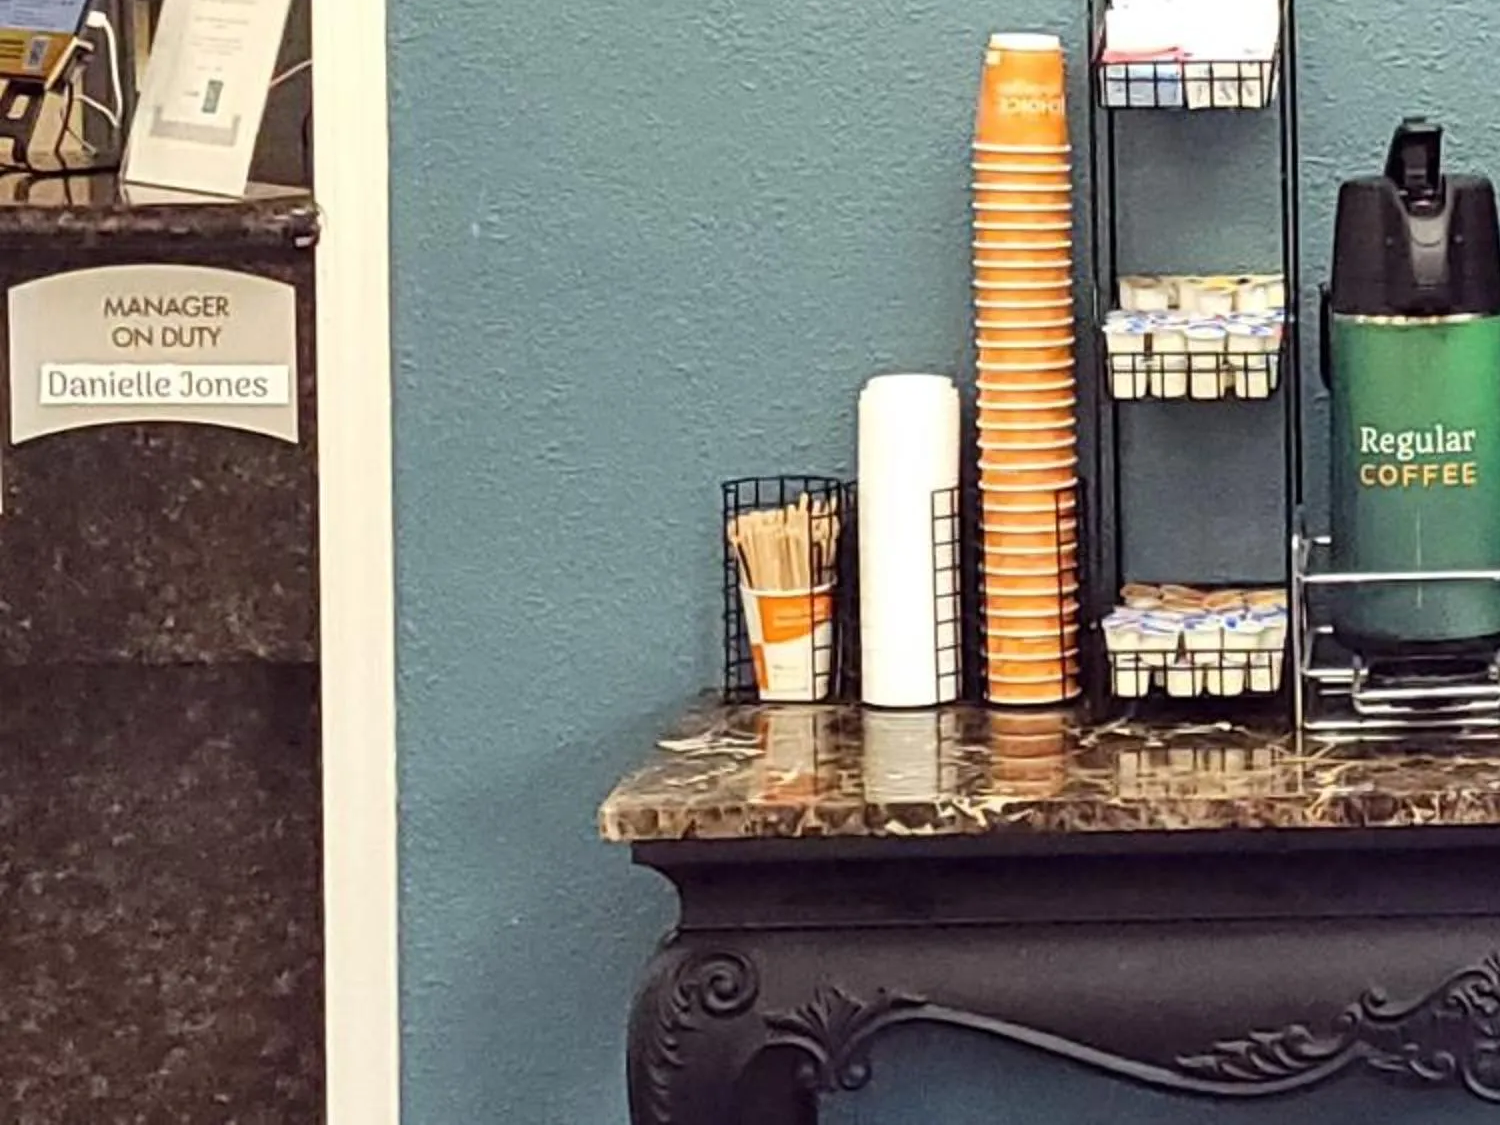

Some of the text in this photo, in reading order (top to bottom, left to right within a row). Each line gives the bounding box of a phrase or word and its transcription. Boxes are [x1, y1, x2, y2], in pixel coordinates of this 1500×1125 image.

[104, 296, 230, 317] MANAGER
[111, 326, 222, 348] ON DUTY
[49, 370, 269, 397] Danielle Jones
[1360, 424, 1476, 461] Regular
[1360, 462, 1478, 488] COFFEE
